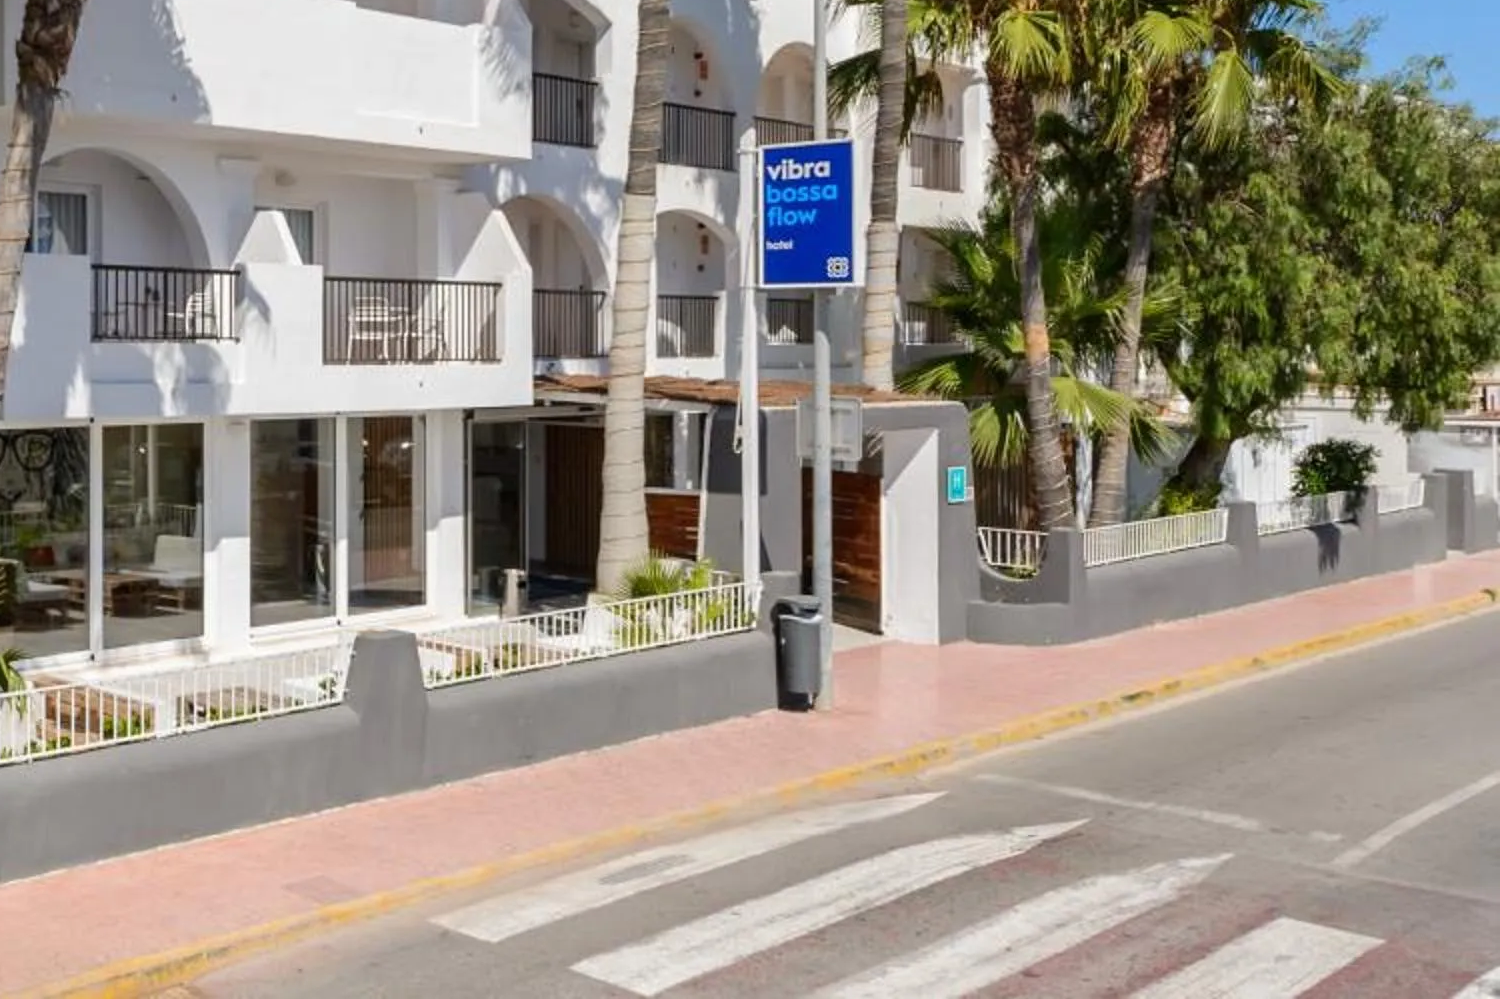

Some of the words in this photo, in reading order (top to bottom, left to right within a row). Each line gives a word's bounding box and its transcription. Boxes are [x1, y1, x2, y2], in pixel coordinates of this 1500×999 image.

[767, 158, 831, 180] vibra
[766, 184, 838, 203] bossa
[767, 206, 817, 227] flow
[766, 238, 793, 250] hotel
